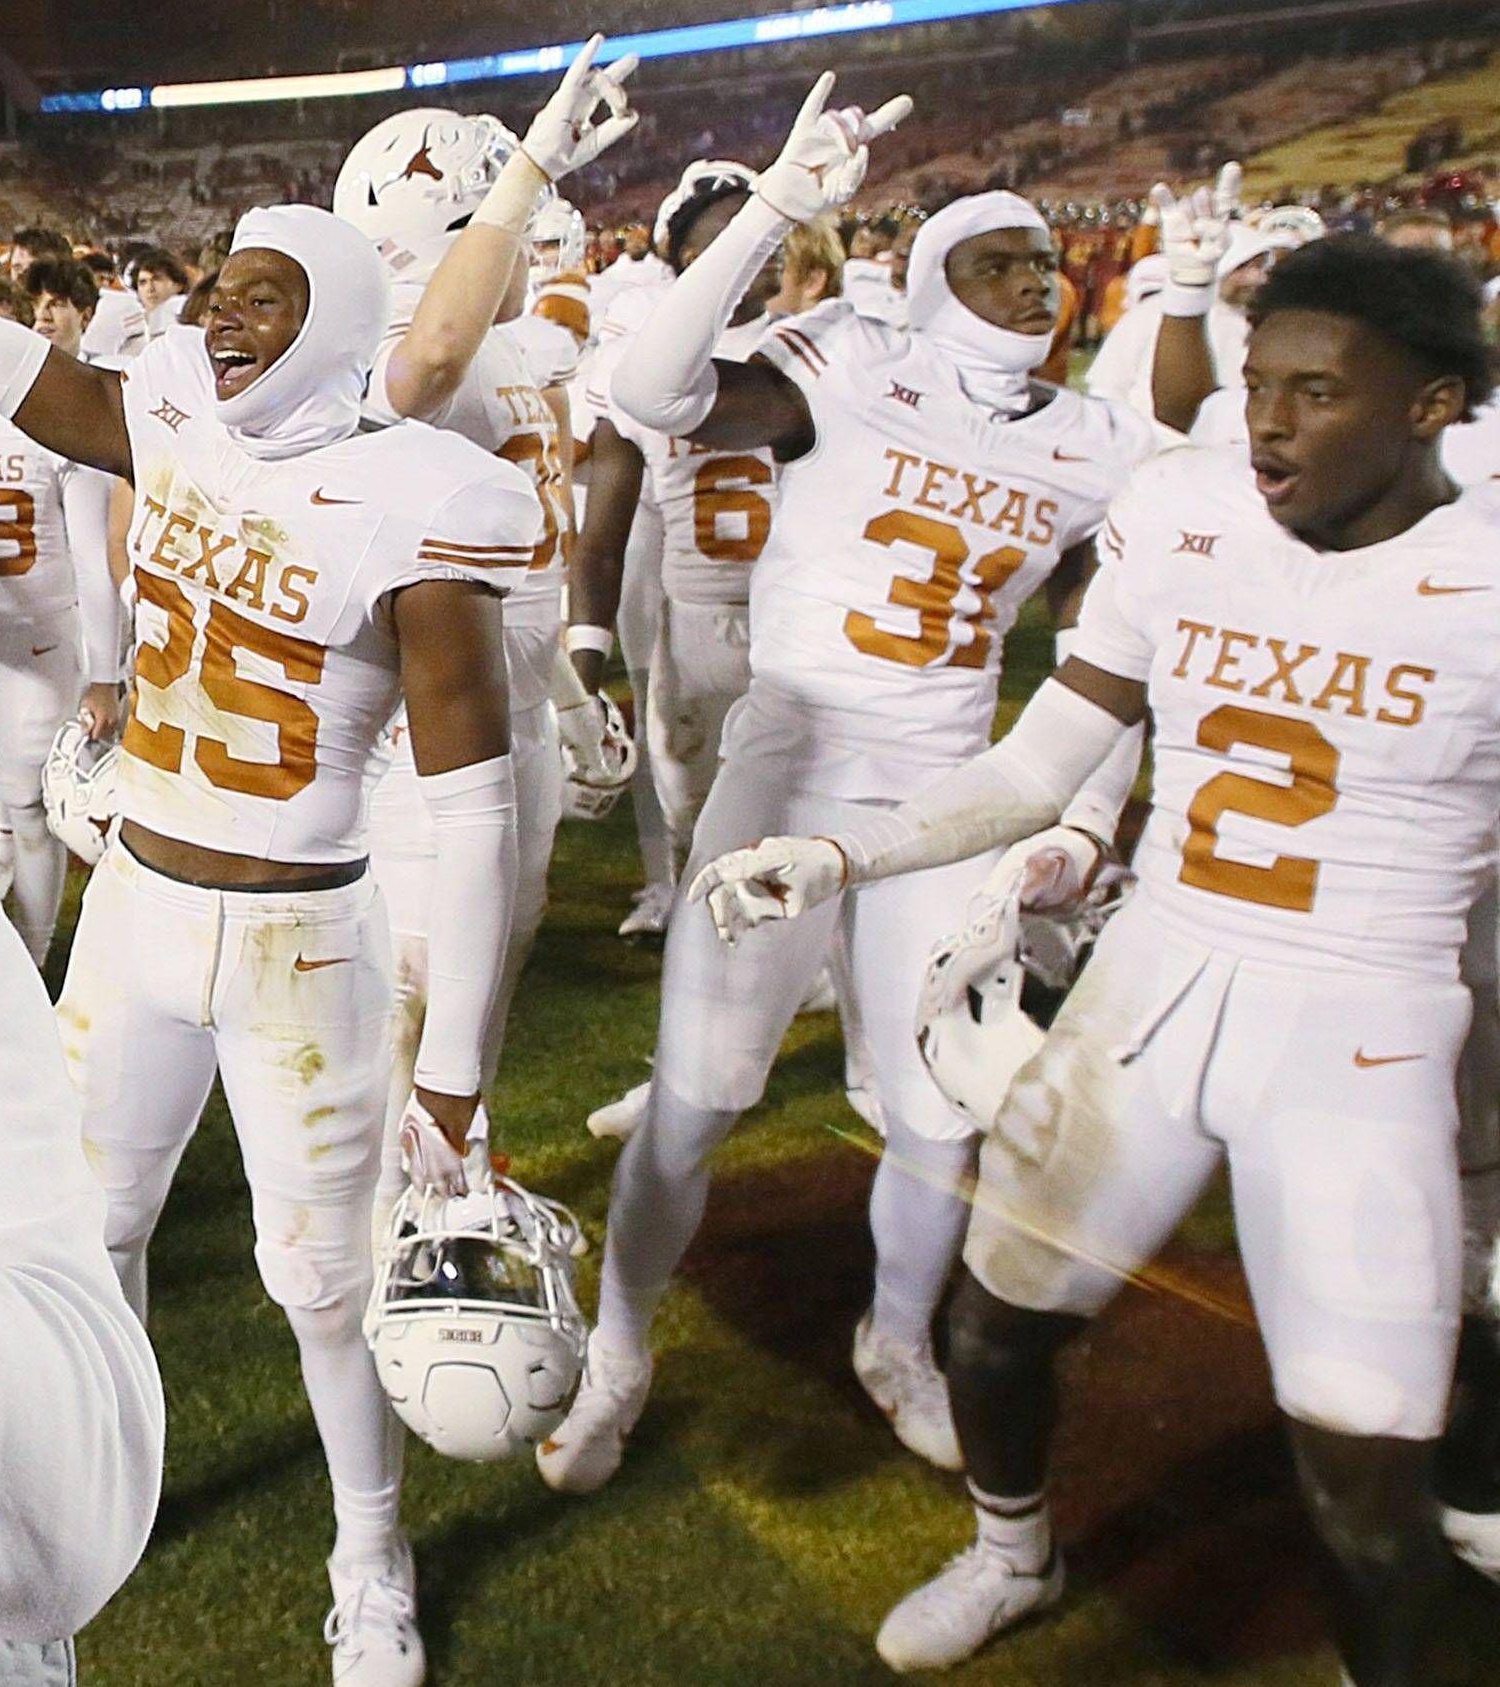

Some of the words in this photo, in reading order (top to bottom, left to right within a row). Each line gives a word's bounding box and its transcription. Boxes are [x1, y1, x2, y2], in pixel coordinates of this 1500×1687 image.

[133, 496, 318, 623] TEXAS
[694, 455, 772, 562] 6
[883, 447, 1059, 546] TEXAS
[843, 508, 1028, 668] 31
[122, 566, 324, 799] 25
[1171, 620, 1435, 726] TEXAS
[1180, 706, 1339, 911] 2
